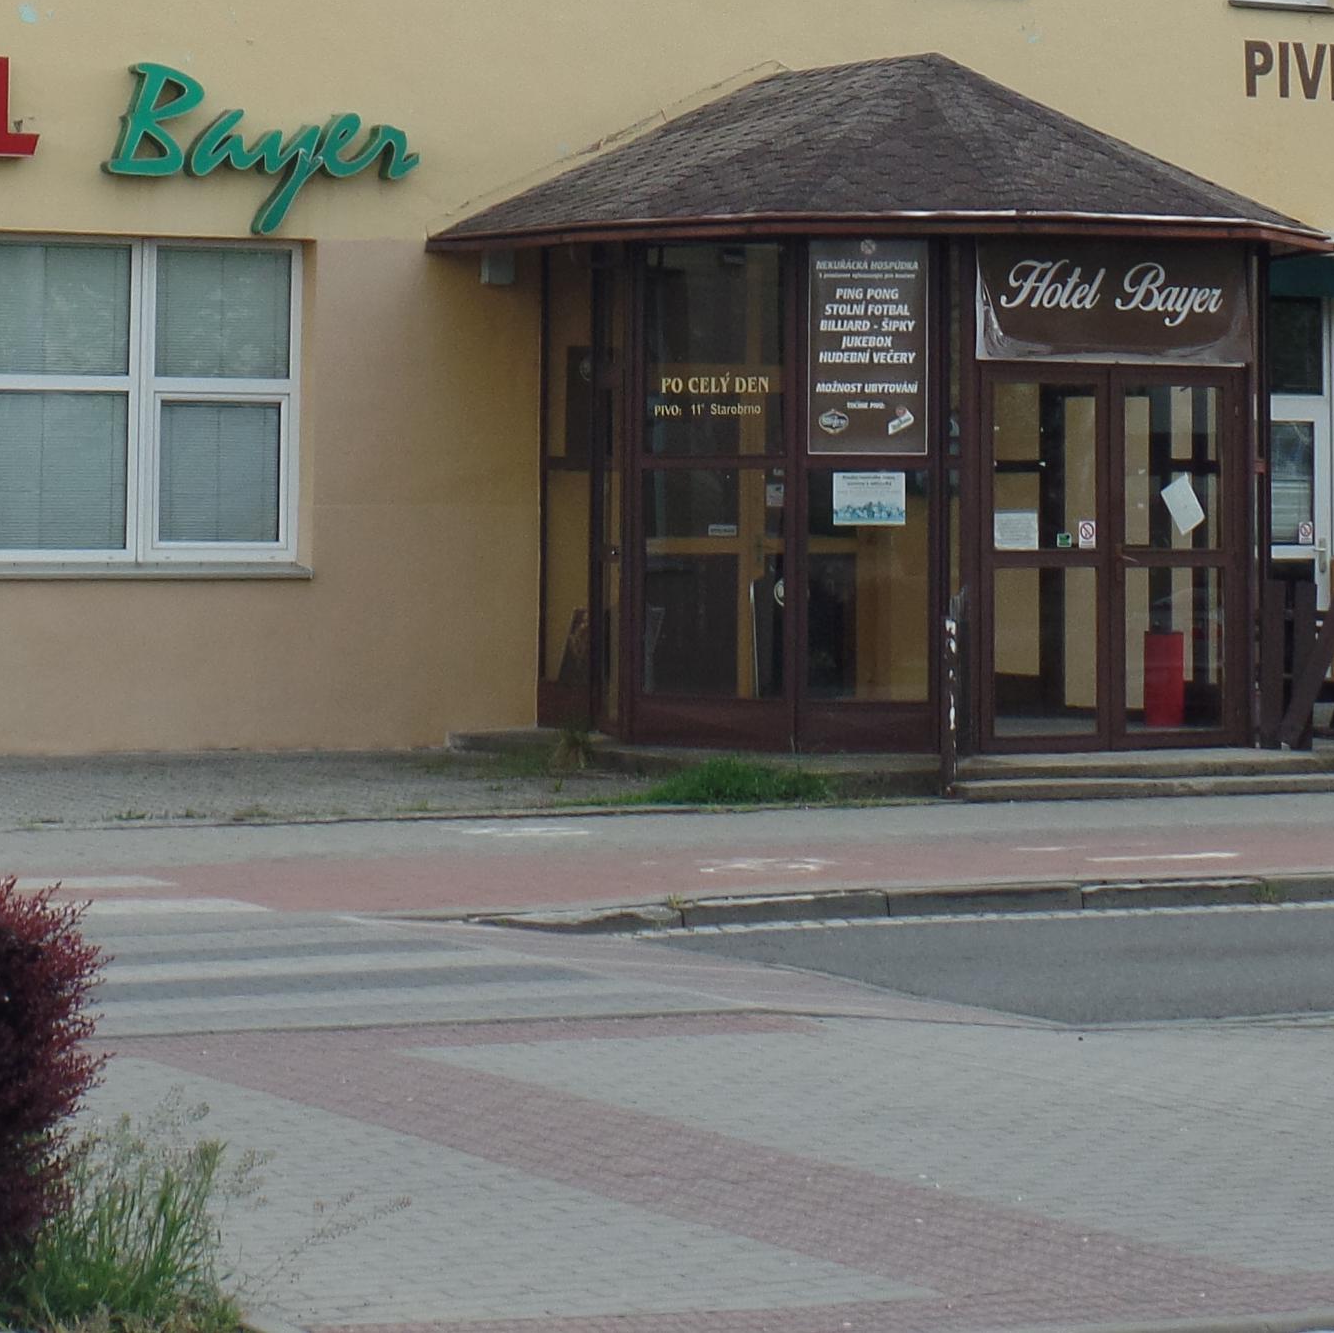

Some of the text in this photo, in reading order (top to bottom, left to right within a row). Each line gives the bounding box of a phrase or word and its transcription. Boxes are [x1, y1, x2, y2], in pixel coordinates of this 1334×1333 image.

[101, 62, 421, 236] Bayer
[835, 288, 900, 300] PING PONG
[1000, 258, 1224, 327] Hotel Bayer
[824, 300, 910, 316] STOLNÍ FOTBAL
[819, 319, 871, 332] BILLIARD
[881, 317, 916, 332] ŠIPKY
[841, 335, 893, 350] JUKEBOX
[818, 348, 917, 364] HUDEBNÍ VEČERY
[688, 371, 730, 394] CELÝ
[734, 376, 770, 393] DEN
[816, 380, 919, 394] MOŽNOST UBYTOVÁNÍ
[710, 403, 762, 415] Starobrno
